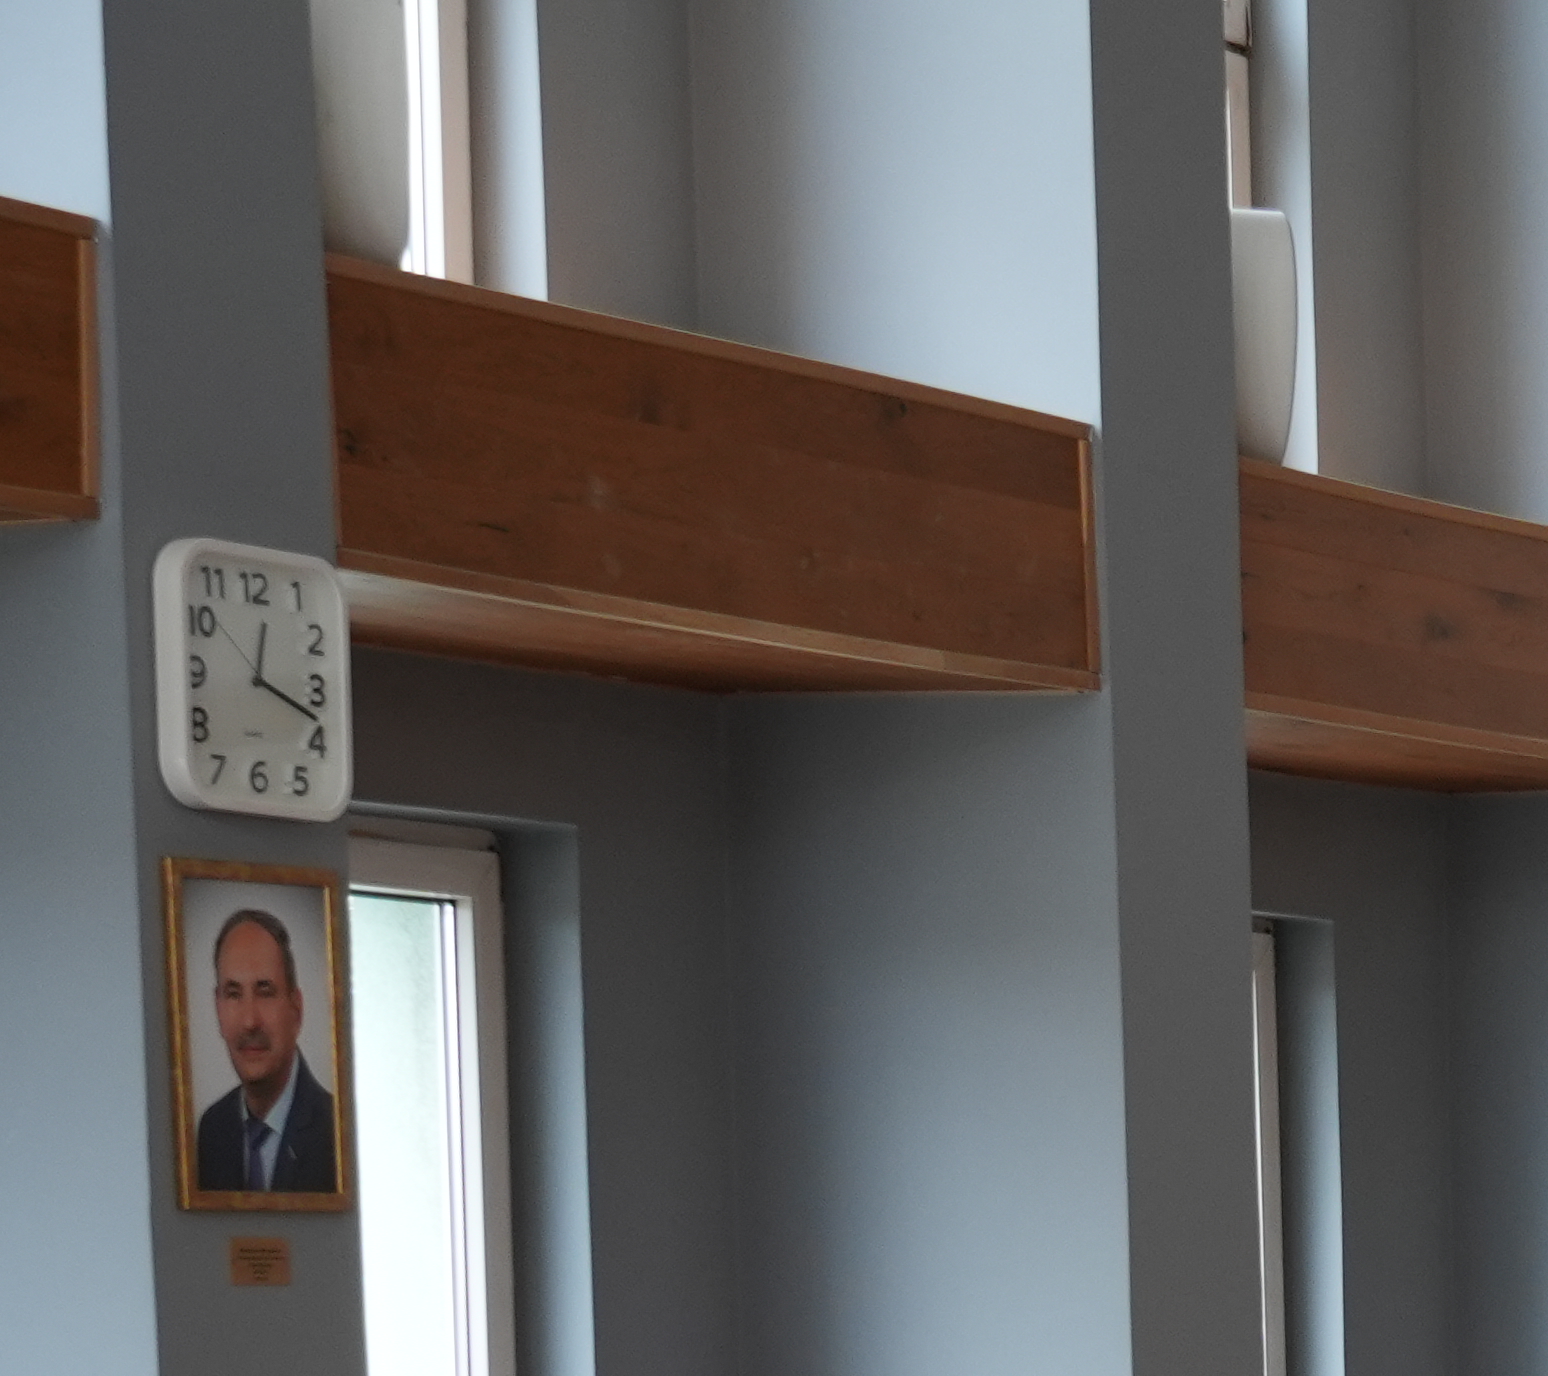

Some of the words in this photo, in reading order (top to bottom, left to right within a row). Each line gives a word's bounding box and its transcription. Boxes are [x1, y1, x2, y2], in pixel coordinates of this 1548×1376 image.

[201, 565, 226, 599] 11
[239, 570, 270, 606] 12
[291, 580, 303, 612] 1
[188, 603, 216, 638] 10
[307, 623, 325, 657] 2
[188, 654, 207, 689] 9
[309, 673, 326, 708] 3
[191, 706, 209, 743] 8
[308, 725, 327, 759] 4
[210, 753, 227, 785] 7
[250, 760, 268, 793] 6
[292, 766, 309, 797] 5
